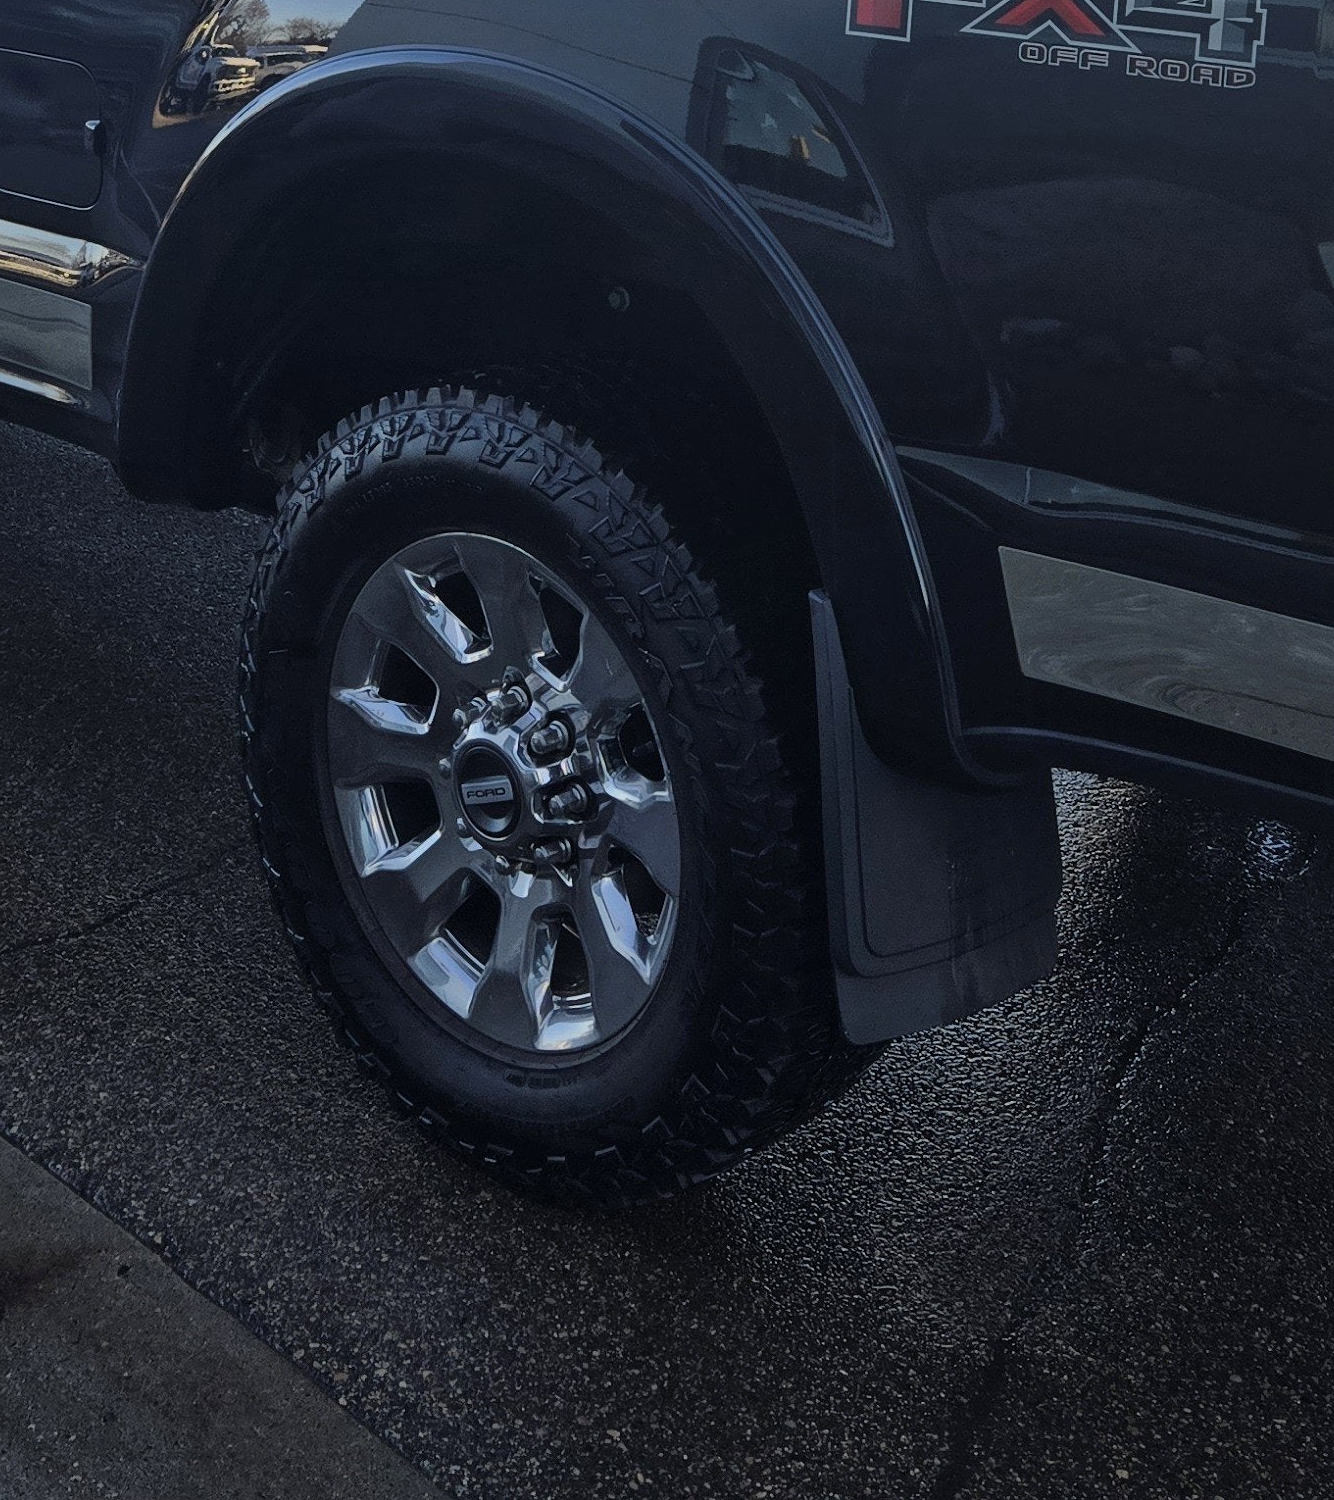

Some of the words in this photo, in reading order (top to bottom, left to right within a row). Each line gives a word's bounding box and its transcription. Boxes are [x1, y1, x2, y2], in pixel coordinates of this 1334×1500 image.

[1018, 41, 1109, 71] OFF
[1126, 54, 1257, 89] ROAD
[467, 787, 506, 799] FORD
